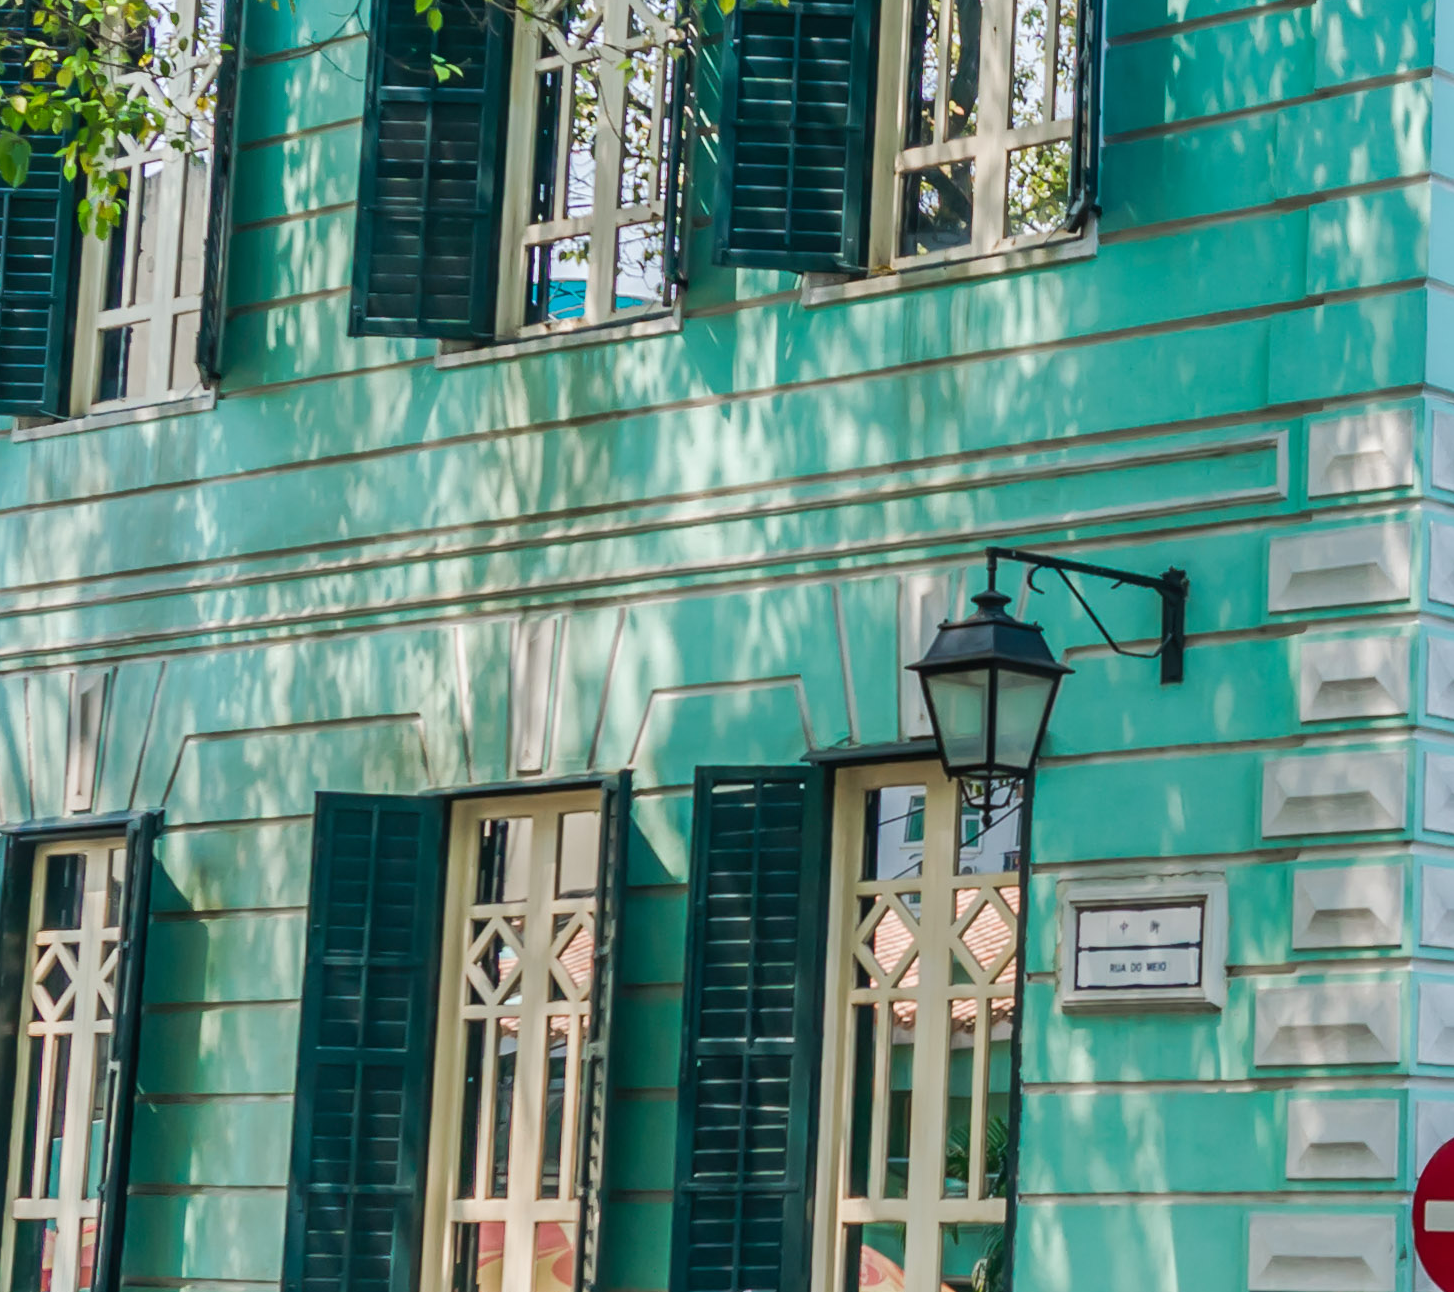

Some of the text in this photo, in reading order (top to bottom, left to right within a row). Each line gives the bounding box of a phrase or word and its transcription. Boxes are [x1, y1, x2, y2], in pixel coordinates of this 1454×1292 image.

[1110, 961, 1167, 973] RUA DO MEIO
